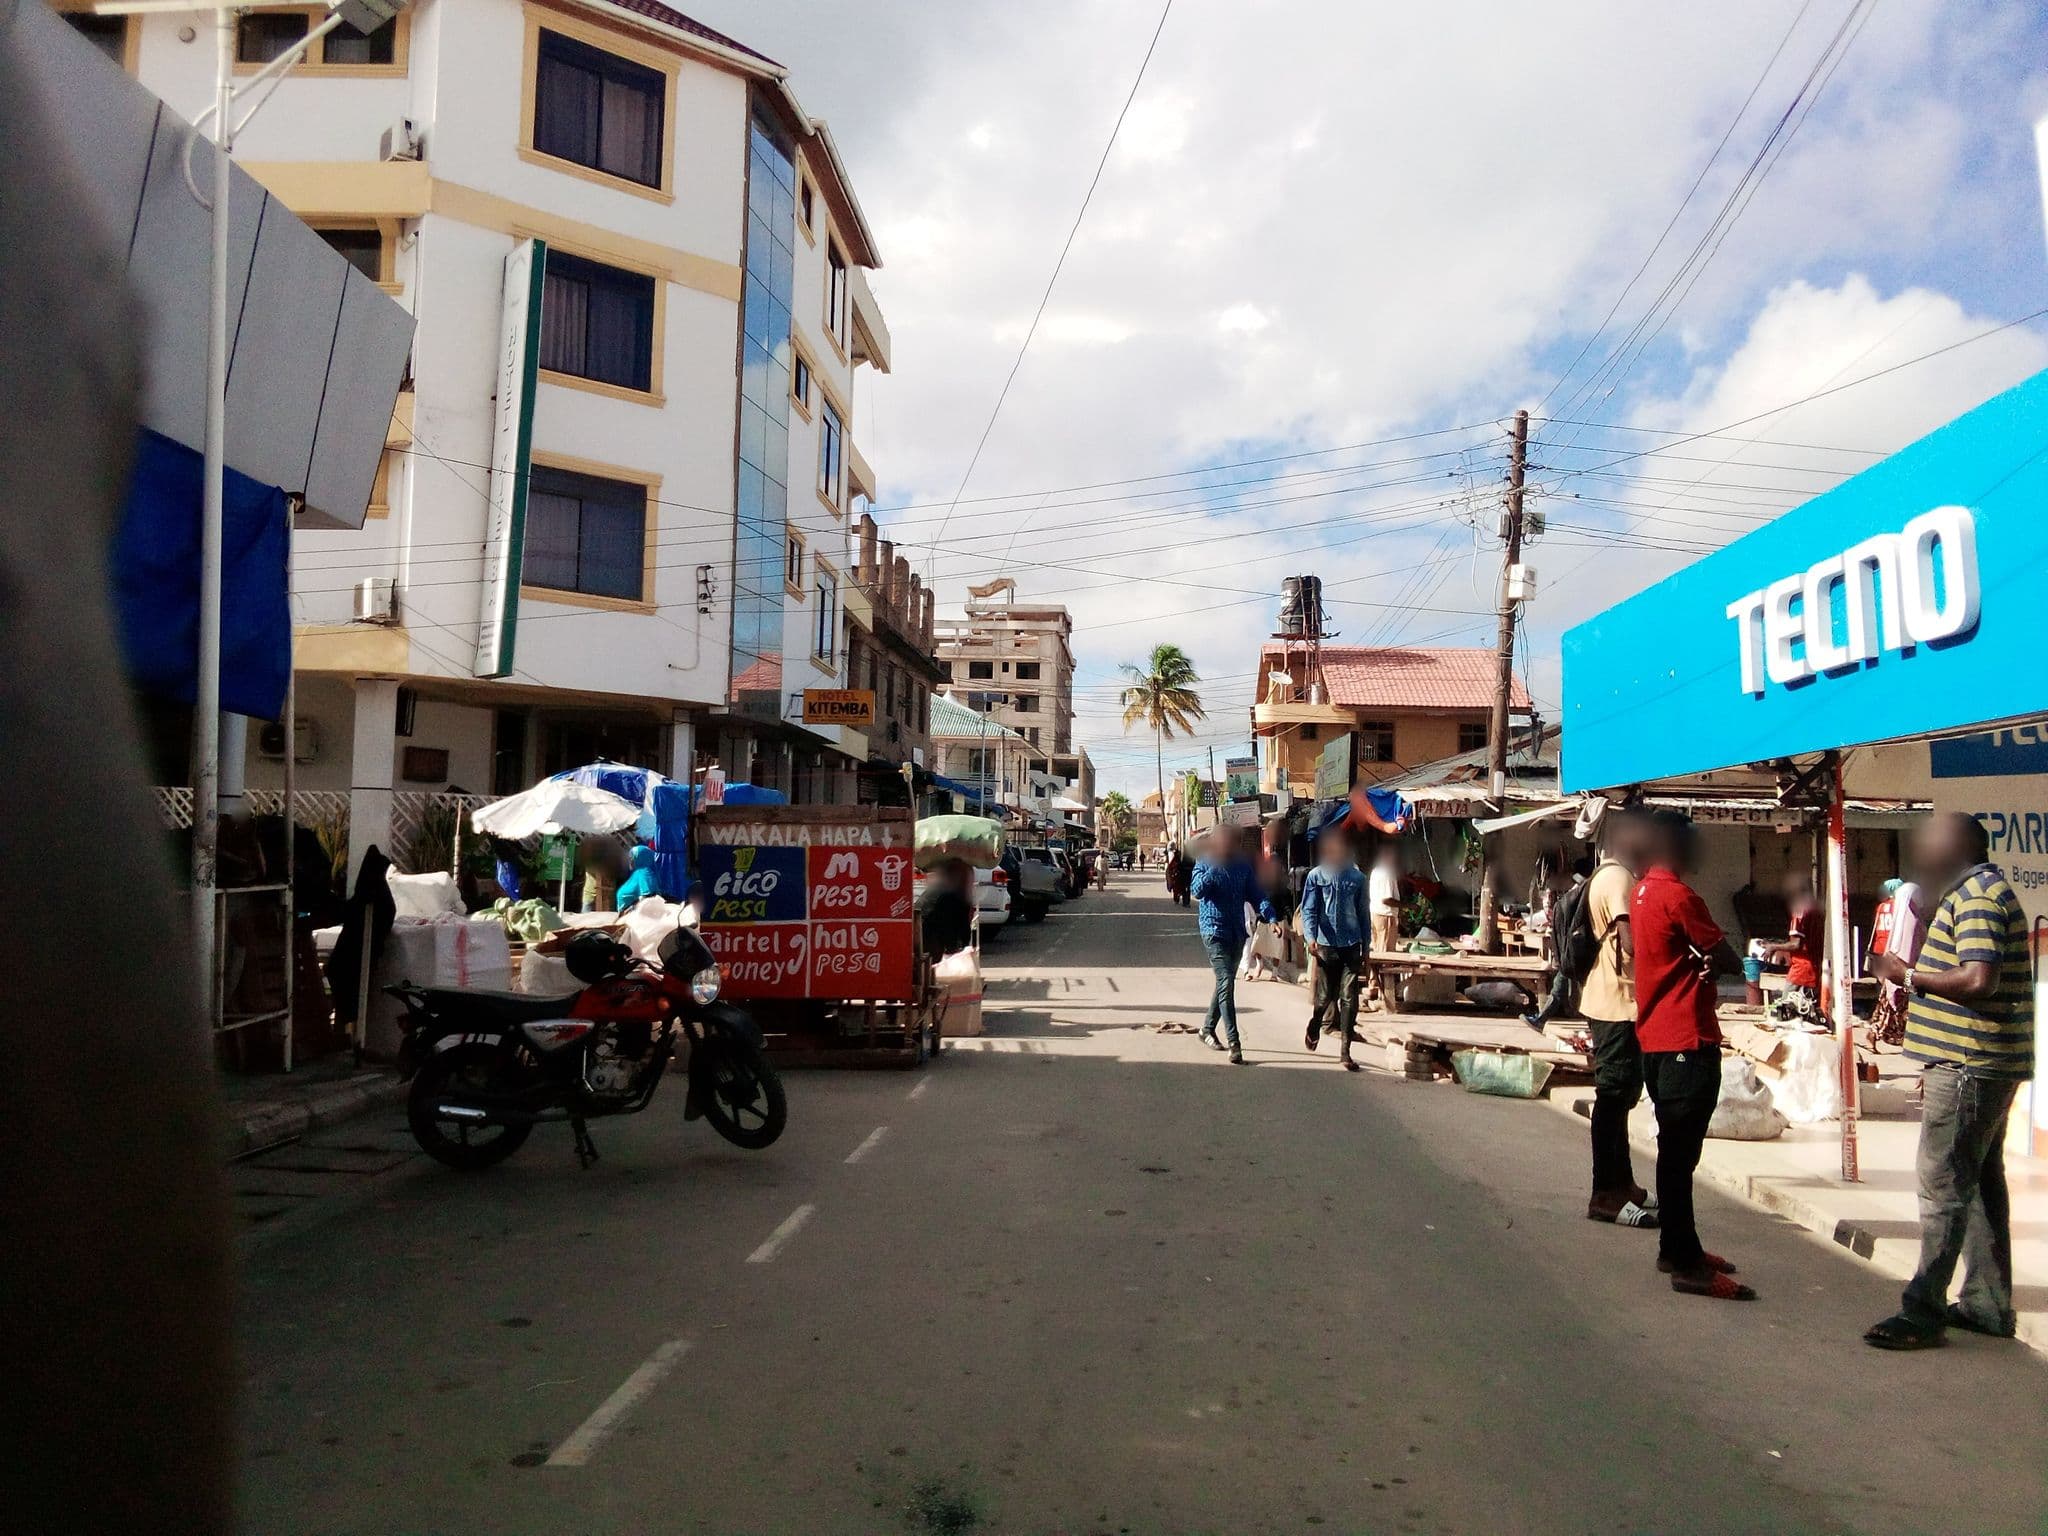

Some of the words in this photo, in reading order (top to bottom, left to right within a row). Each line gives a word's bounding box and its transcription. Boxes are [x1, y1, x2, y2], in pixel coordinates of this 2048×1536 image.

[1726, 505, 1981, 696] TECNO
[808, 701, 870, 715] KITEMBA
[817, 691, 860, 701] HOTEL
[1689, 807, 1771, 823] ESPECT
[709, 823, 812, 846] WAKALA
[821, 825, 873, 846] HAPA
[823, 851, 859, 879] M
[2012, 864, 2048, 889] Bigge
[710, 898, 767, 919] pesa
[811, 884, 868, 910] pesa
[710, 930, 780, 954] airtel
[815, 923, 879, 949] halo
[816, 952, 881, 976] pesa
